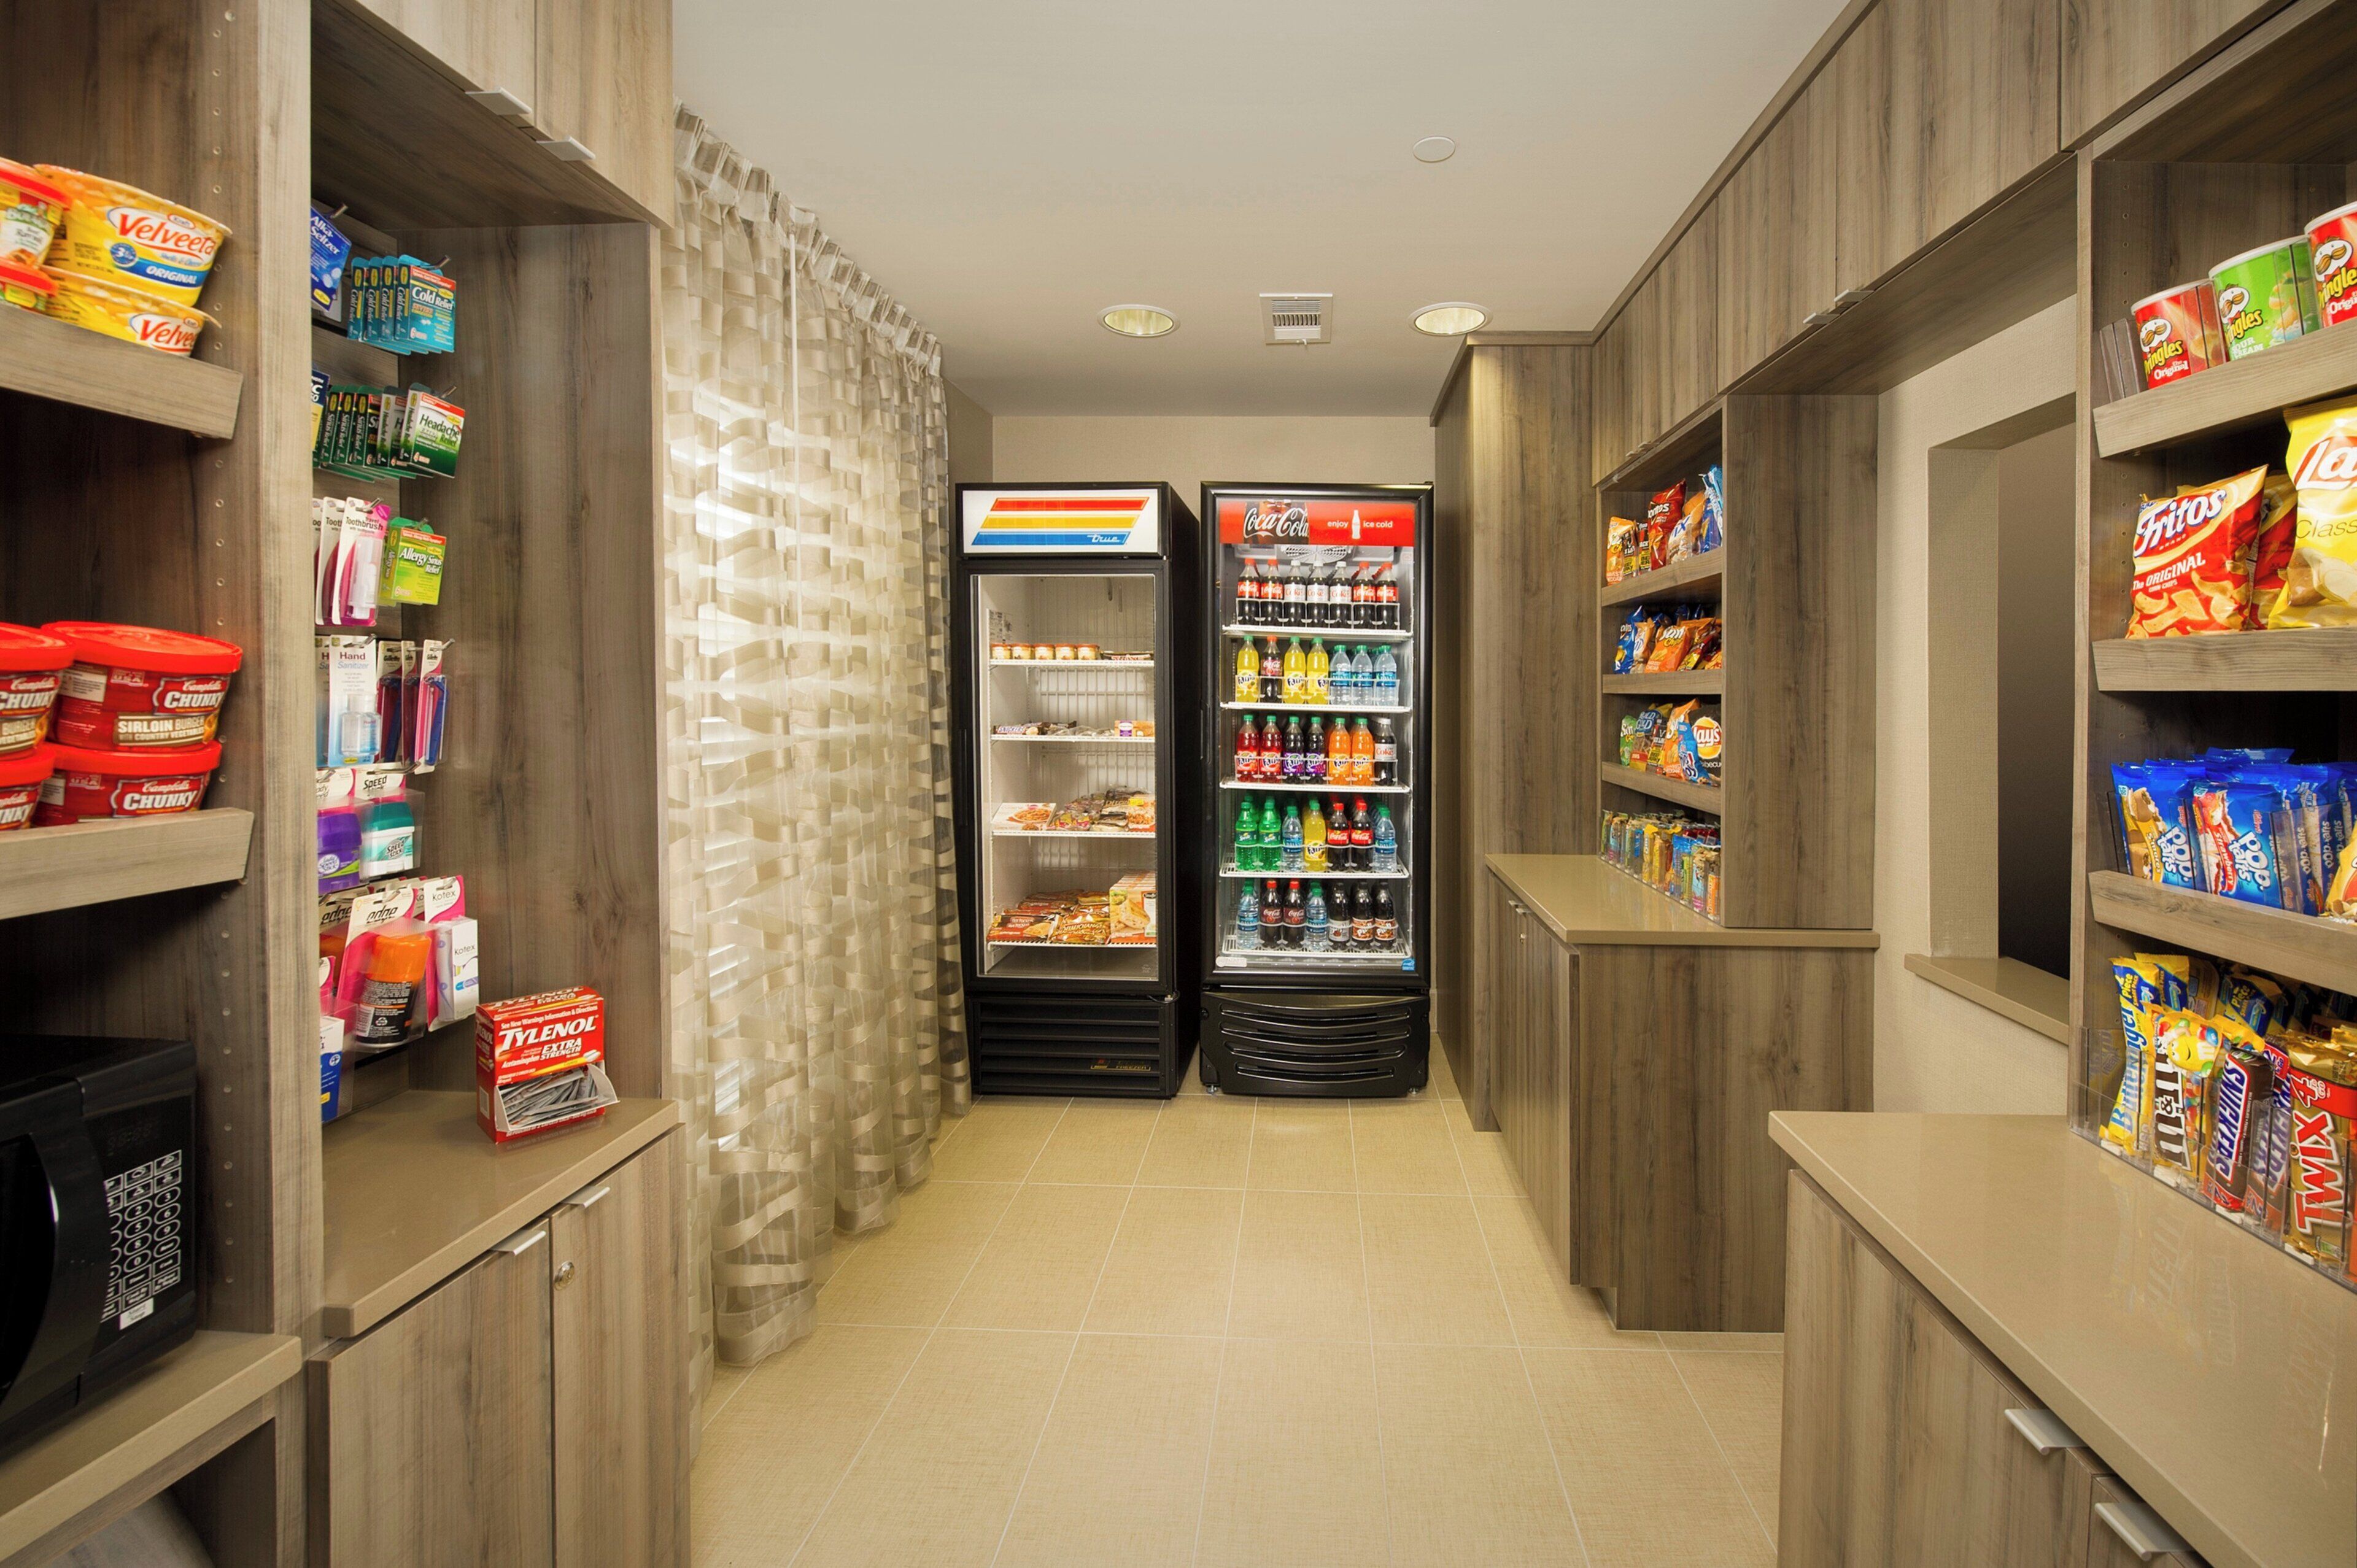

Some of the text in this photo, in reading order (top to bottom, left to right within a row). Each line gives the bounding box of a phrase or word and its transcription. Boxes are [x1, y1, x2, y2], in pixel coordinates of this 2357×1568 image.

[116, 212, 217, 256] Velveeta
[311, 226, 340, 255] Seltzer
[146, 266, 197, 284] ORIGINAL
[412, 287, 453, 311] Cold Relief
[2154, 360, 2190, 380] Original
[419, 414, 460, 438] Headache
[440, 434, 457, 447] Relief
[346, 517, 383, 531] Toothbrush
[1327, 520, 1393, 529] enjoy ice cold
[2134, 489, 2227, 558] Fritos
[2296, 519, 2357, 539] Class
[2159, 534, 2187, 550] BRAND
[400, 547, 442, 566] Allergy Sinus
[425, 565, 441, 574] Relief
[2132, 552, 2206, 591] The ORIGINAL
[2148, 578, 2178, 593] CORN CHIPS
[1659, 625, 1686, 641] Sun
[339, 652, 366, 660] Hand
[338, 661, 370, 670] Sanitizer
[164, 692, 225, 708] CHUNKY
[118, 716, 205, 733] SIRLOIN BURGER
[1635, 719, 1653, 730] GOLD
[134, 732, 169, 741] COUNTRY
[363, 776, 387, 790] SPEED
[123, 790, 197, 810] CHUNKY
[2214, 831, 2234, 887] Strawberry
[2121, 973, 2133, 998] Piece
[522, 1015, 544, 1026] Warnings
[544, 1011, 571, 1021] Information
[576, 1005, 598, 1014] Directions
[498, 1016, 597, 1051] TYLENOL
[540, 1046, 582, 1060] STRENGTH
[542, 1037, 582, 1054] EXTRA
[2290, 1074, 2318, 1108] 4
[2216, 1064, 2246, 1178] SNICKERS
[135, 1206, 142, 1216] 2
[164, 1210, 171, 1218] 6
[163, 1226, 170, 1235] 9
